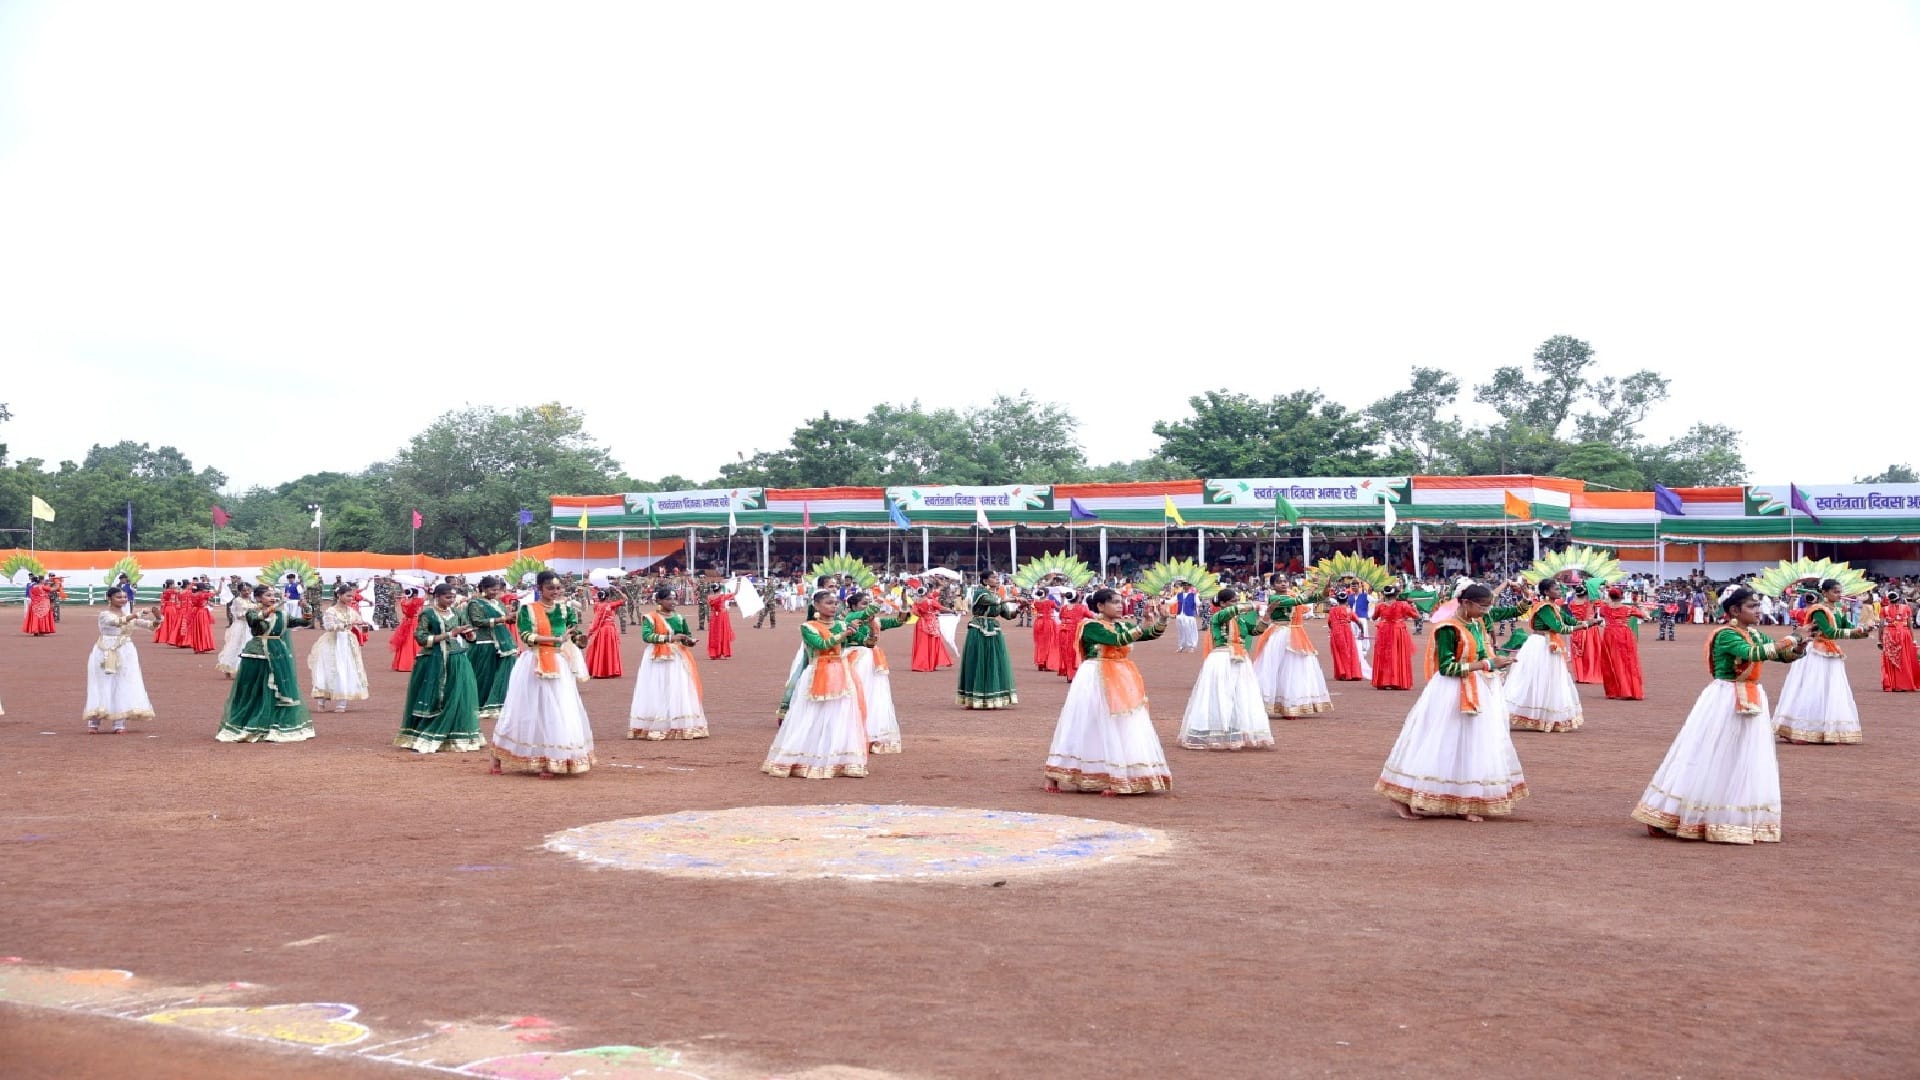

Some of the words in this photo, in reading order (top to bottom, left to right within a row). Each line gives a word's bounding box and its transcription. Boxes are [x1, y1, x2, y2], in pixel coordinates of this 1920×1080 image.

[1291, 485, 1315, 499] दिवस
[1318, 487, 1341, 499] अमर
[1343, 485, 1357, 499] रहे
[1815, 493, 1866, 510] स्वतंत्रता
[1868, 492, 1904, 509] दिवस
